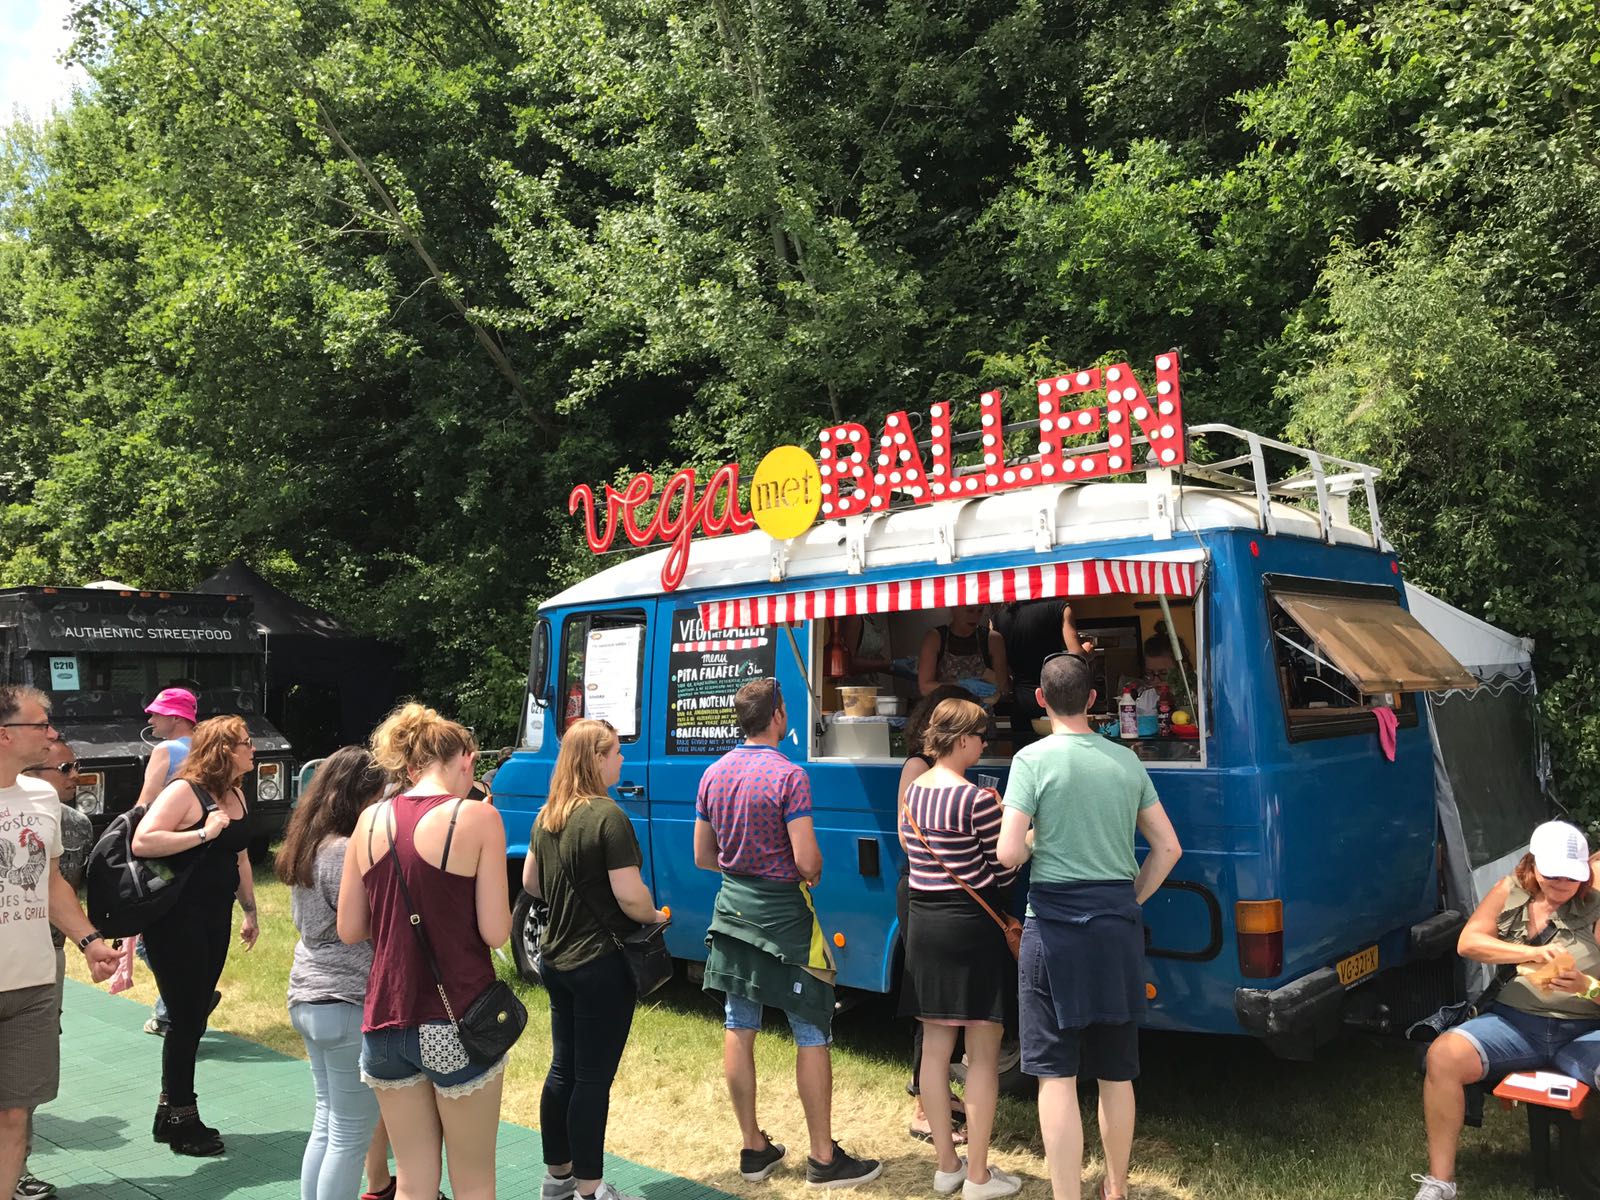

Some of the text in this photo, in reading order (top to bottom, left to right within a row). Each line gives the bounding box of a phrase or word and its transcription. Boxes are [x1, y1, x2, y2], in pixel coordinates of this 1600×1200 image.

[568, 352, 1185, 592] vega met BALLEN
[65, 627, 232, 640] AUTHENTIC STREETFOOD
[701, 653, 728, 663] menu
[53, 661, 74, 670] C210
[700, 664, 740, 681] FALAFEL
[747, 662, 754, 675] 3
[676, 723, 740, 738] BALLENBAKJE
[0, 812, 43, 832] oster
[13, 911, 22, 921] &
